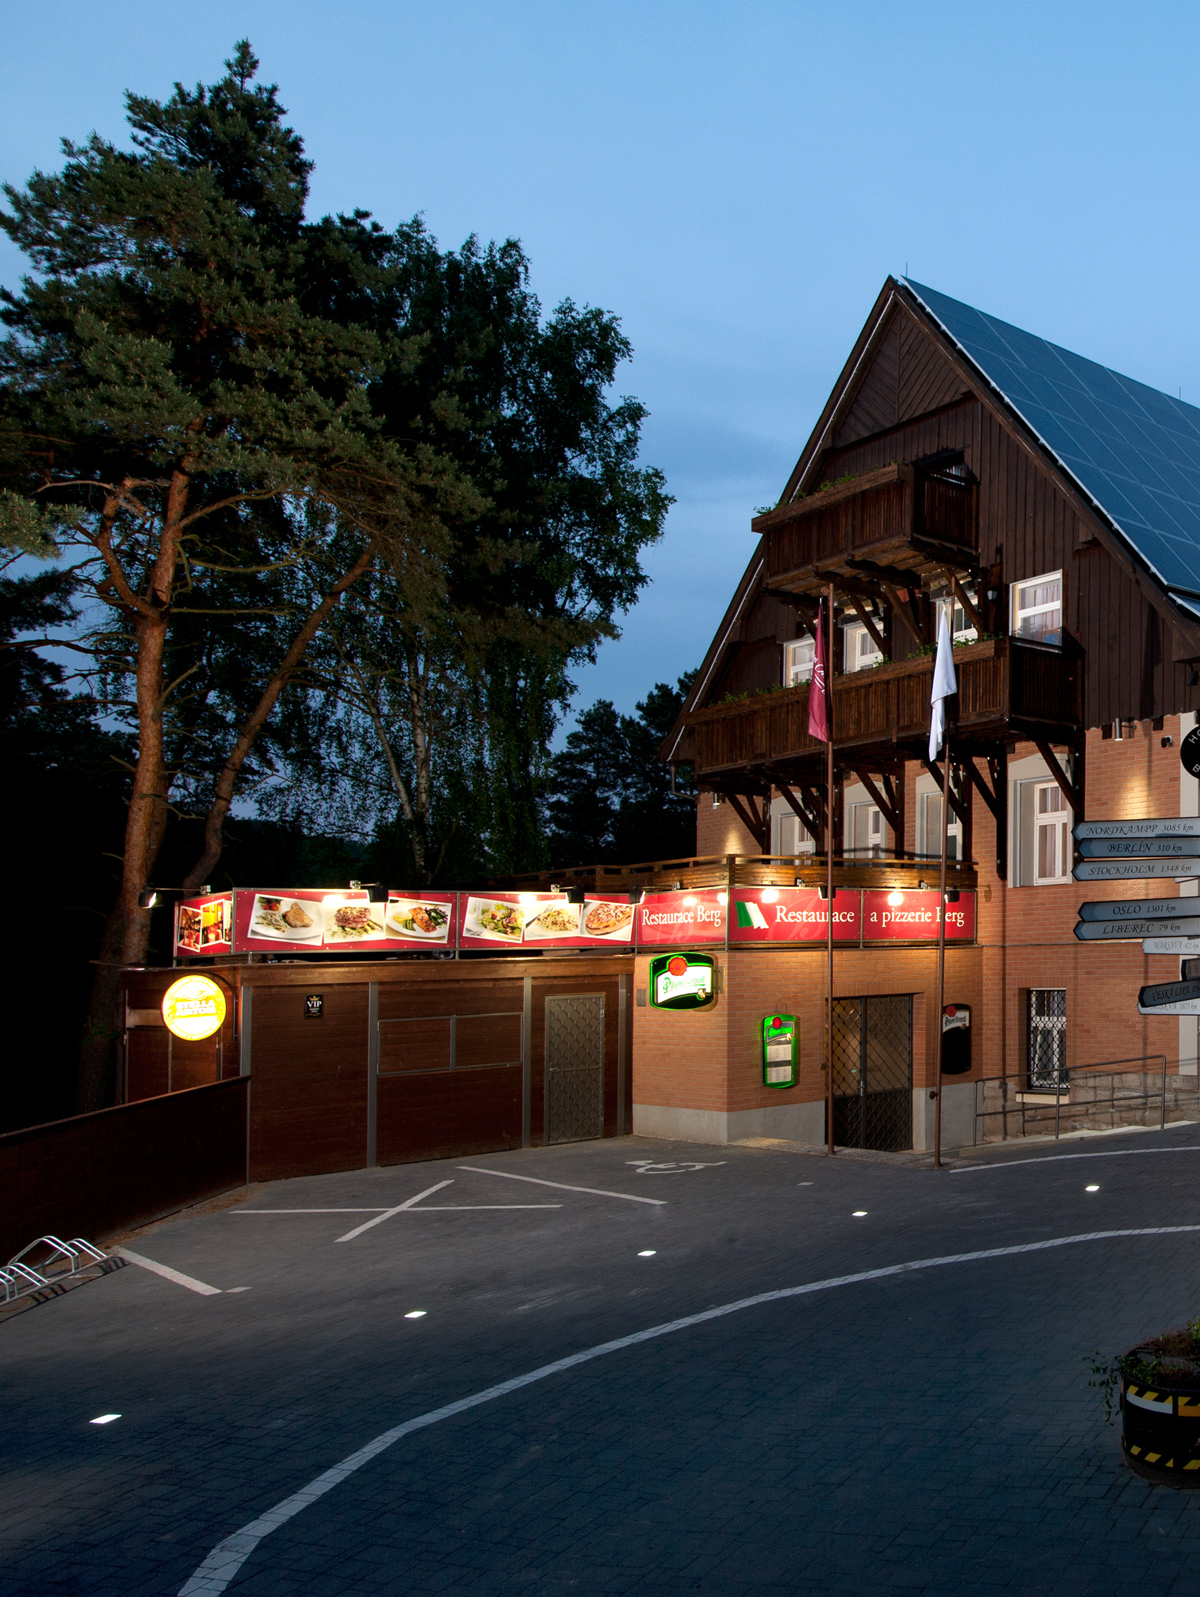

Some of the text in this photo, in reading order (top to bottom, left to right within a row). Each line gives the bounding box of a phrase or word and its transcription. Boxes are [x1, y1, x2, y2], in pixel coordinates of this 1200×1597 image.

[1086, 823, 1194, 836] NORDKAMPP 3085 km
[1107, 841, 1183, 854] BERLÍN 310 km
[1088, 863, 1192, 876] STOCKHOLM 1348 km
[642, 904, 722, 927] Restaurace Berg
[1112, 903, 1176, 915] OSLO 1301 km
[870, 912, 878, 923] a
[881, 907, 932, 928] pizzerie
[1102, 923, 1181, 934] LIBEREC 79 km
[306, 1000, 322, 1008] VIP
